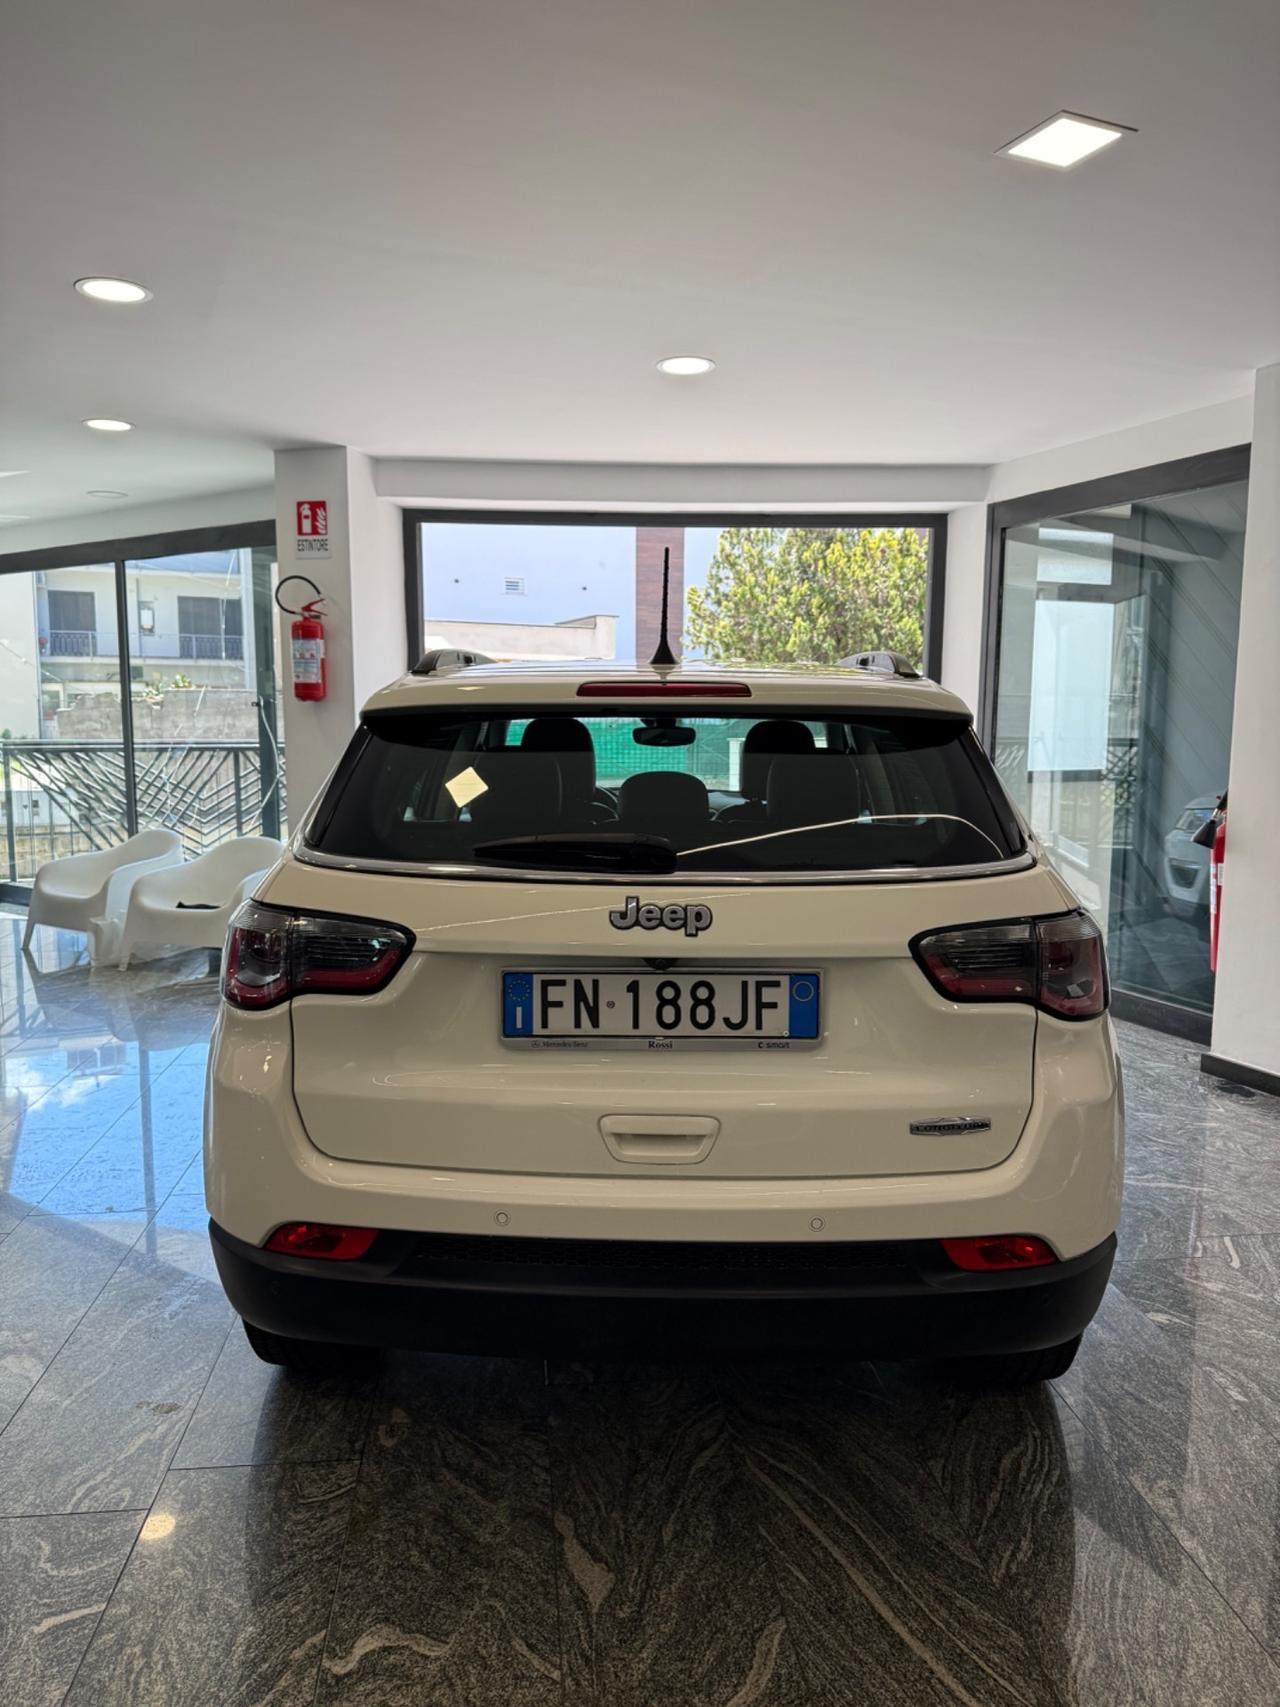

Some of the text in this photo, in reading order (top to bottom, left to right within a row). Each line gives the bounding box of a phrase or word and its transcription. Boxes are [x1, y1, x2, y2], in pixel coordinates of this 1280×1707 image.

[609, 896, 713, 937] Jeep
[540, 979, 600, 1030] FN
[626, 979, 781, 1030] 188JF
[648, 1040, 673, 1049] Rossi
